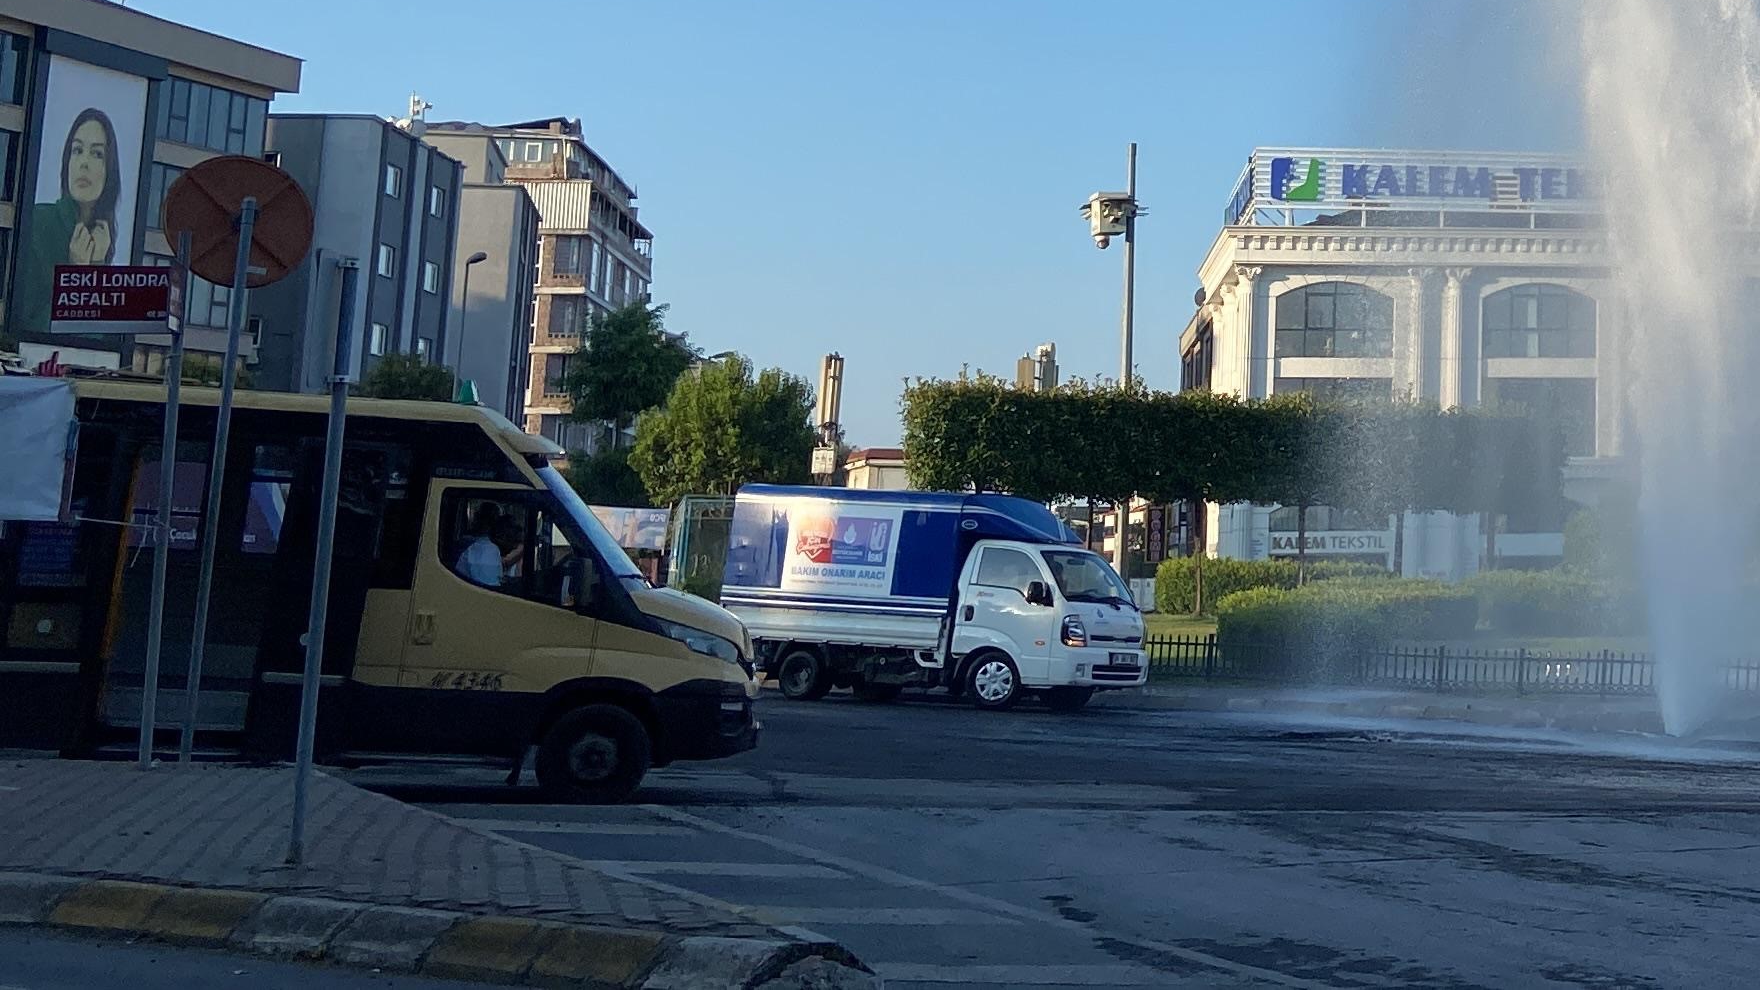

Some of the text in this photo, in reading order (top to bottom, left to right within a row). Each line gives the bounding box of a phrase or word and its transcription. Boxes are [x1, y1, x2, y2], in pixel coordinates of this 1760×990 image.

[1342, 163, 1493, 199] KALEM
[60, 271, 169, 287] ESKİ LONDRA
[57, 292, 126, 306] ASFALTI
